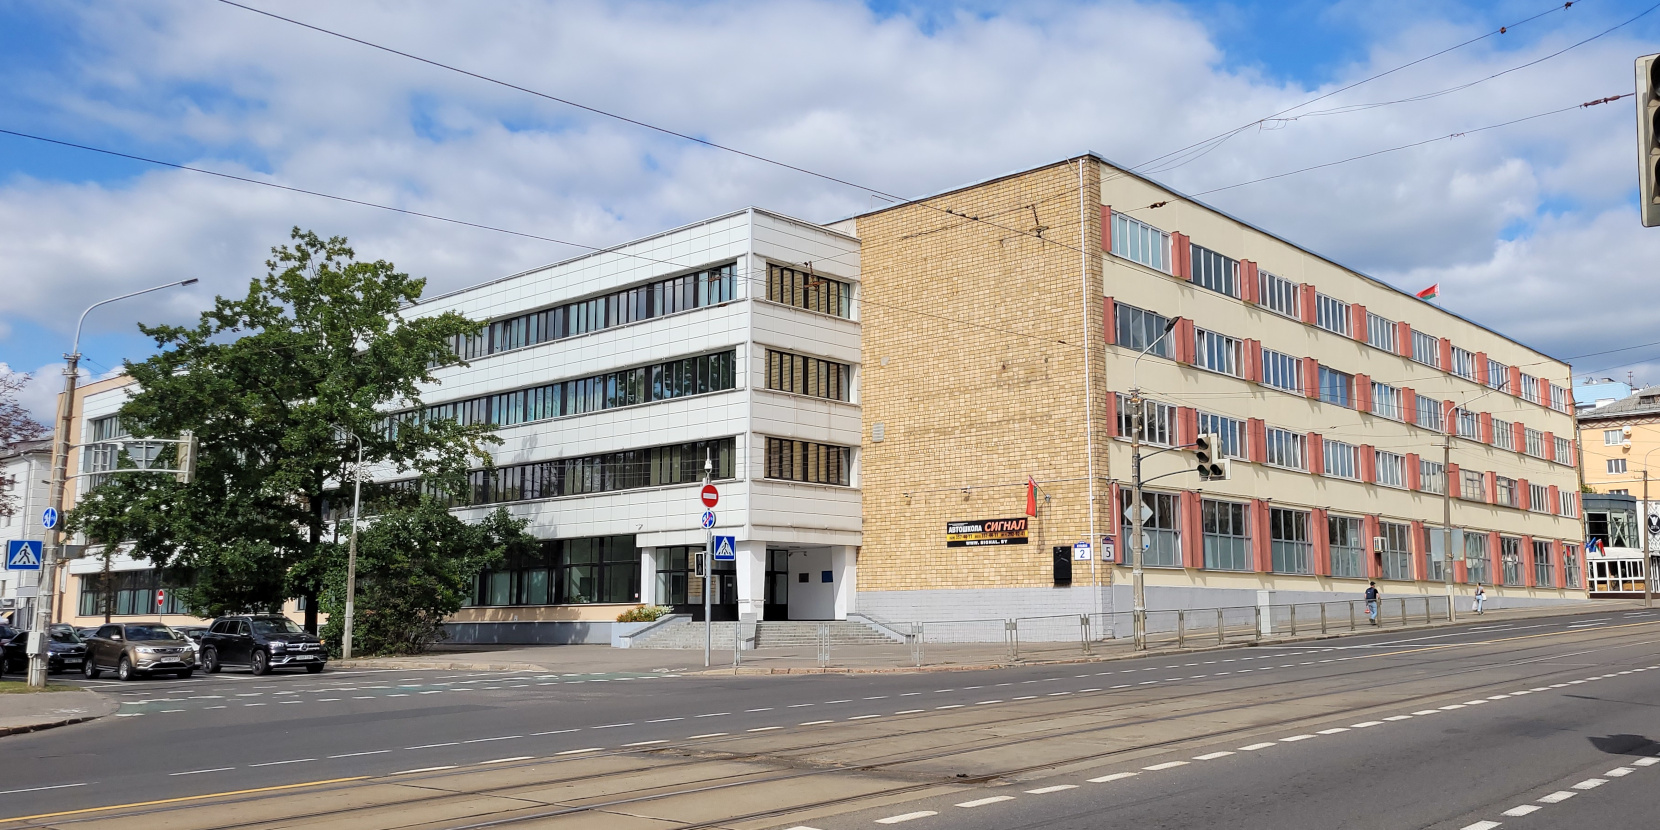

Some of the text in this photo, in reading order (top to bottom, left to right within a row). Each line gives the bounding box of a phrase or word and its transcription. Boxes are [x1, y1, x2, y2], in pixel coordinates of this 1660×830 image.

[948, 520, 1025, 533] АВТОШКОЛА СИГНАЛ
[1079, 549, 1085, 559] 2
[1105, 546, 1111, 558] 5
